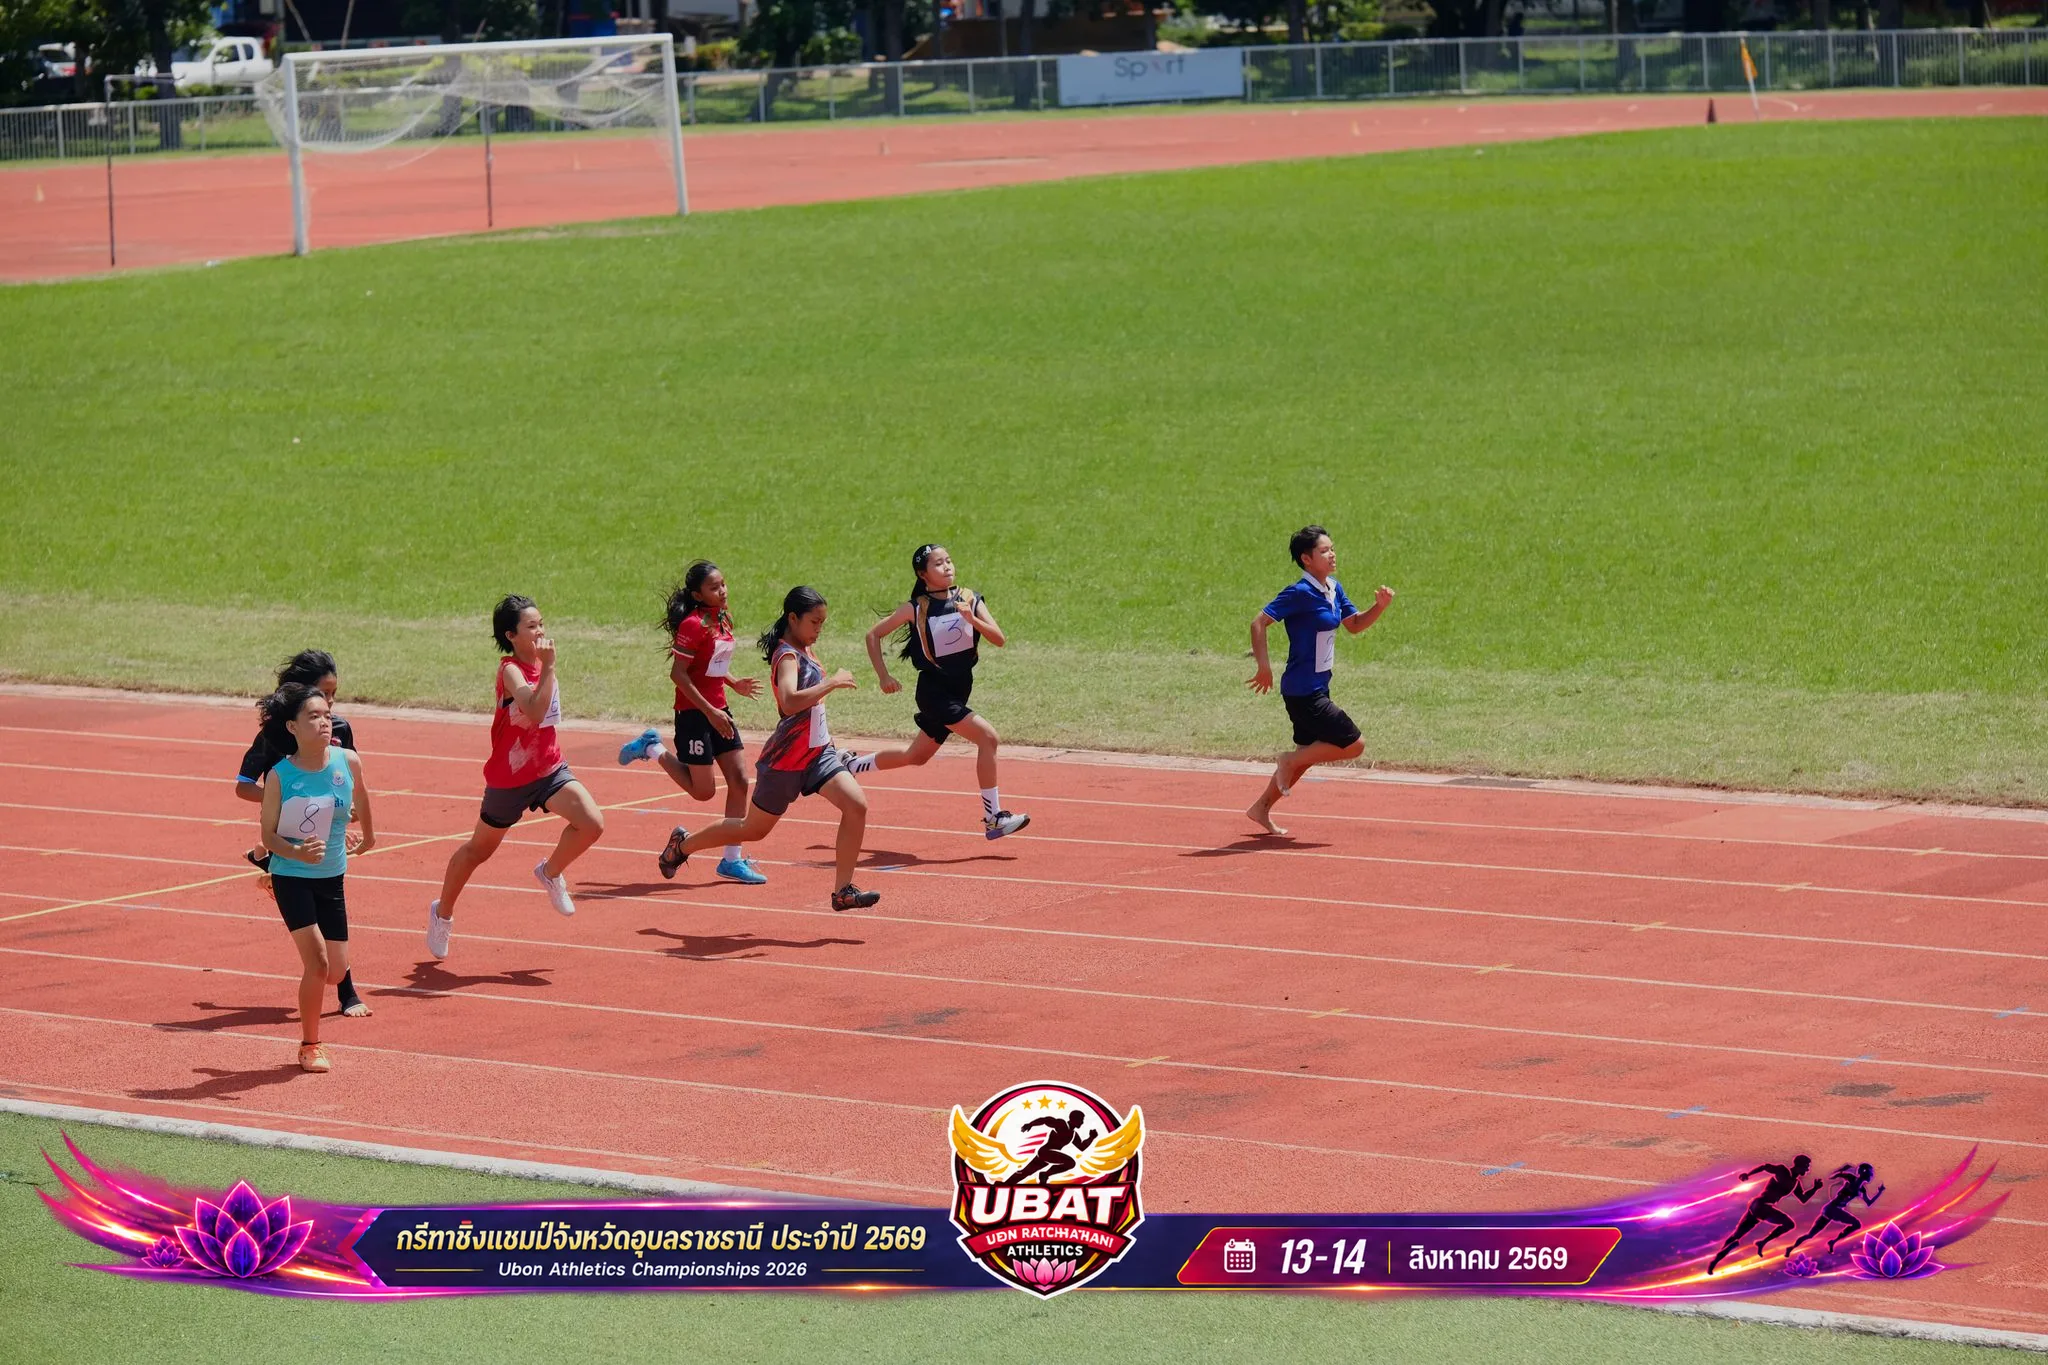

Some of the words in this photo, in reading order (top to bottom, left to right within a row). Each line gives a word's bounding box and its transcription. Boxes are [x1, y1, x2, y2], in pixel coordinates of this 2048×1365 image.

[941, 618, 963, 646] 3
[688, 739, 705, 756] 16
[299, 803, 320, 834] 8
